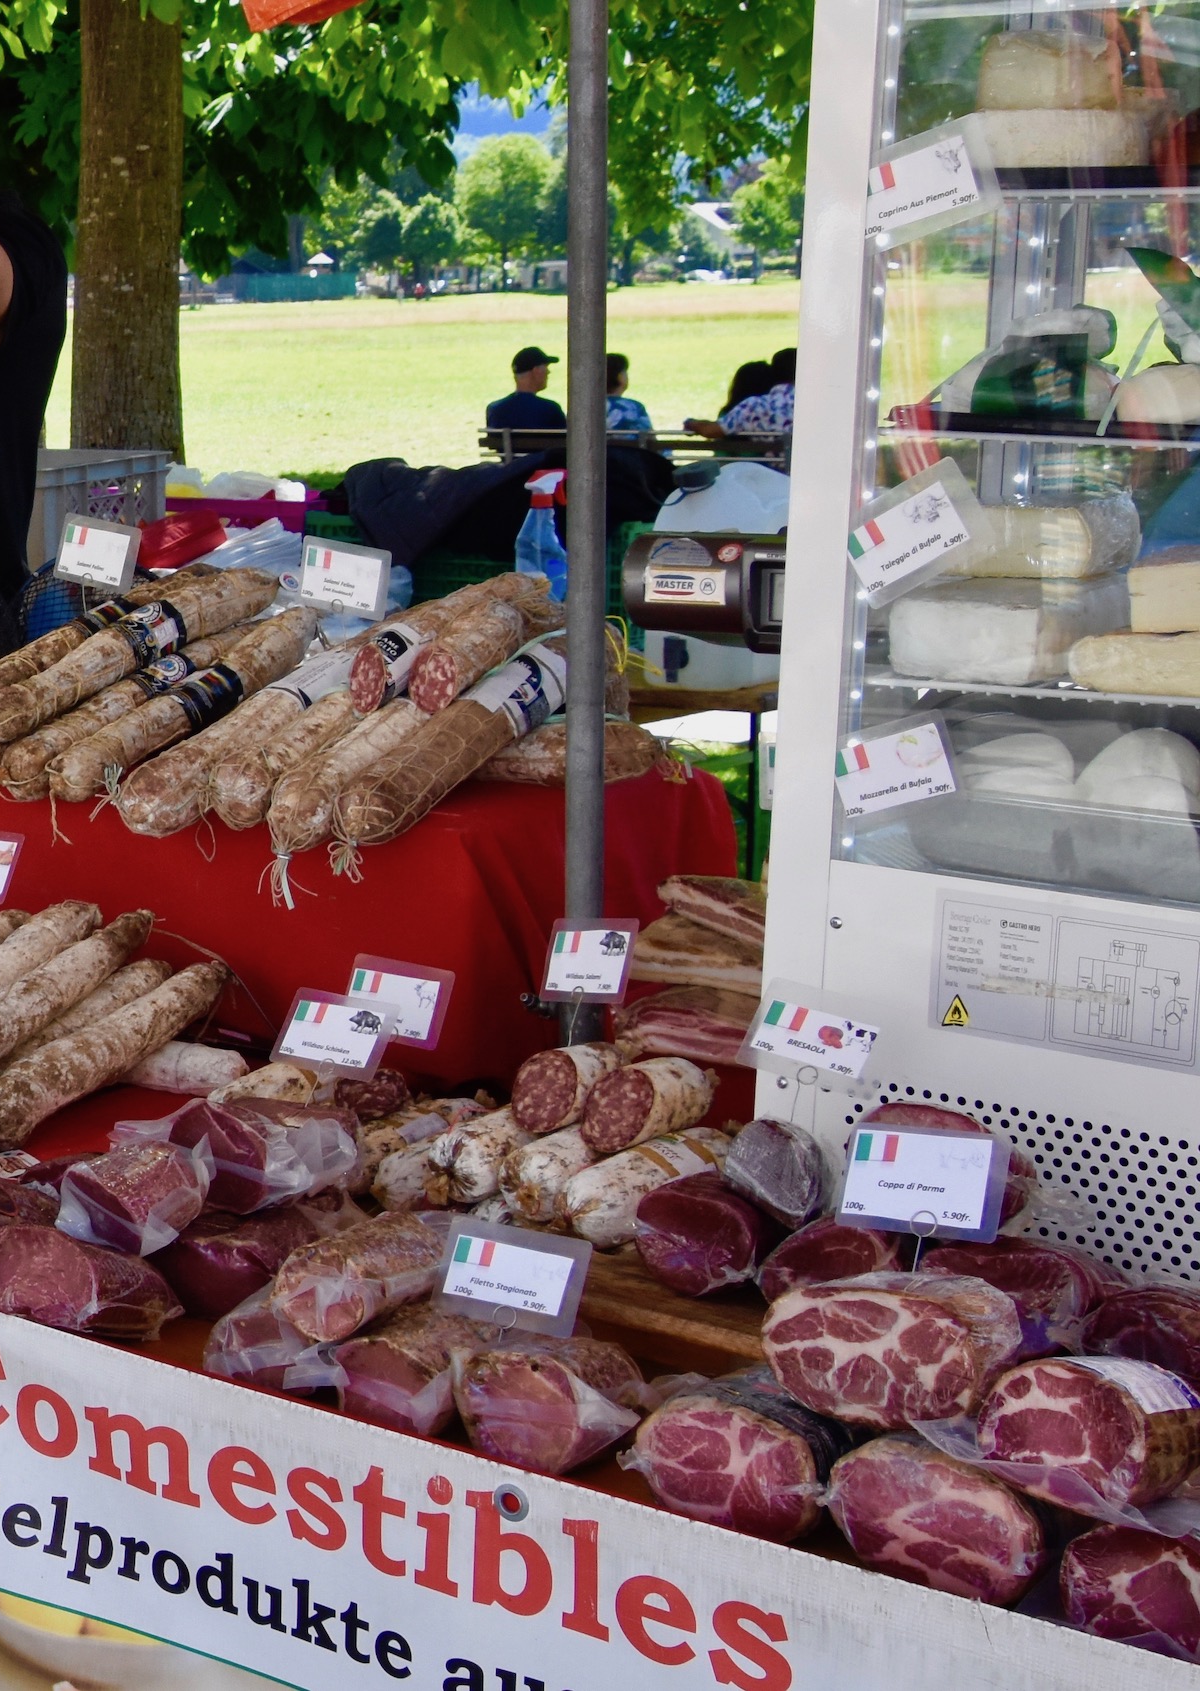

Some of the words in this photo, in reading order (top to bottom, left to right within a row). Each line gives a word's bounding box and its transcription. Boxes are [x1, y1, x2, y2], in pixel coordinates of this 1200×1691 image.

[878, 204, 908, 219] Caprino
[910, 198, 924, 208] Aus
[926, 188, 958, 203] Piemont
[952, 194, 978, 206] 5.90fr.
[944, 533, 967, 548] 4.90fr.
[881, 552, 910, 572] Taleggio
[912, 546, 918, 555] di
[919, 534, 942, 550] Bufala
[324, 577, 340, 585] Salami
[655, 580, 694, 590] MASTER
[867, 580, 885, 593] 100g.
[860, 785, 898, 801] Mozzarella
[900, 782, 907, 790] di
[909, 777, 932, 788] Bufala
[928, 783, 952, 795] 3.90fr.
[846, 807, 865, 816] 100g.
[403, 1028, 422, 1038] 7.90fr.
[301, 1040, 324, 1050] Wildsau
[325, 1044, 350, 1055] Schinken
[787, 1038, 826, 1055] BRESAOLA
[341, 1057, 363, 1067] 12.00fr.
[755, 1040, 775, 1052] 100g.
[829, 1062, 854, 1076] 9.90fr.
[878, 1180, 904, 1190] Coppa
[906, 1182, 915, 1190] di
[916, 1184, 946, 1193] Parma
[844, 1201, 866, 1211] 100g.
[941, 1211, 971, 1223] 5.90fr.
[470, 1277, 495, 1289] Filetto
[496, 1282, 537, 1298] Stagionato
[453, 1285, 474, 1296] 100g.
[522, 1300, 548, 1312] 9.90fr.
